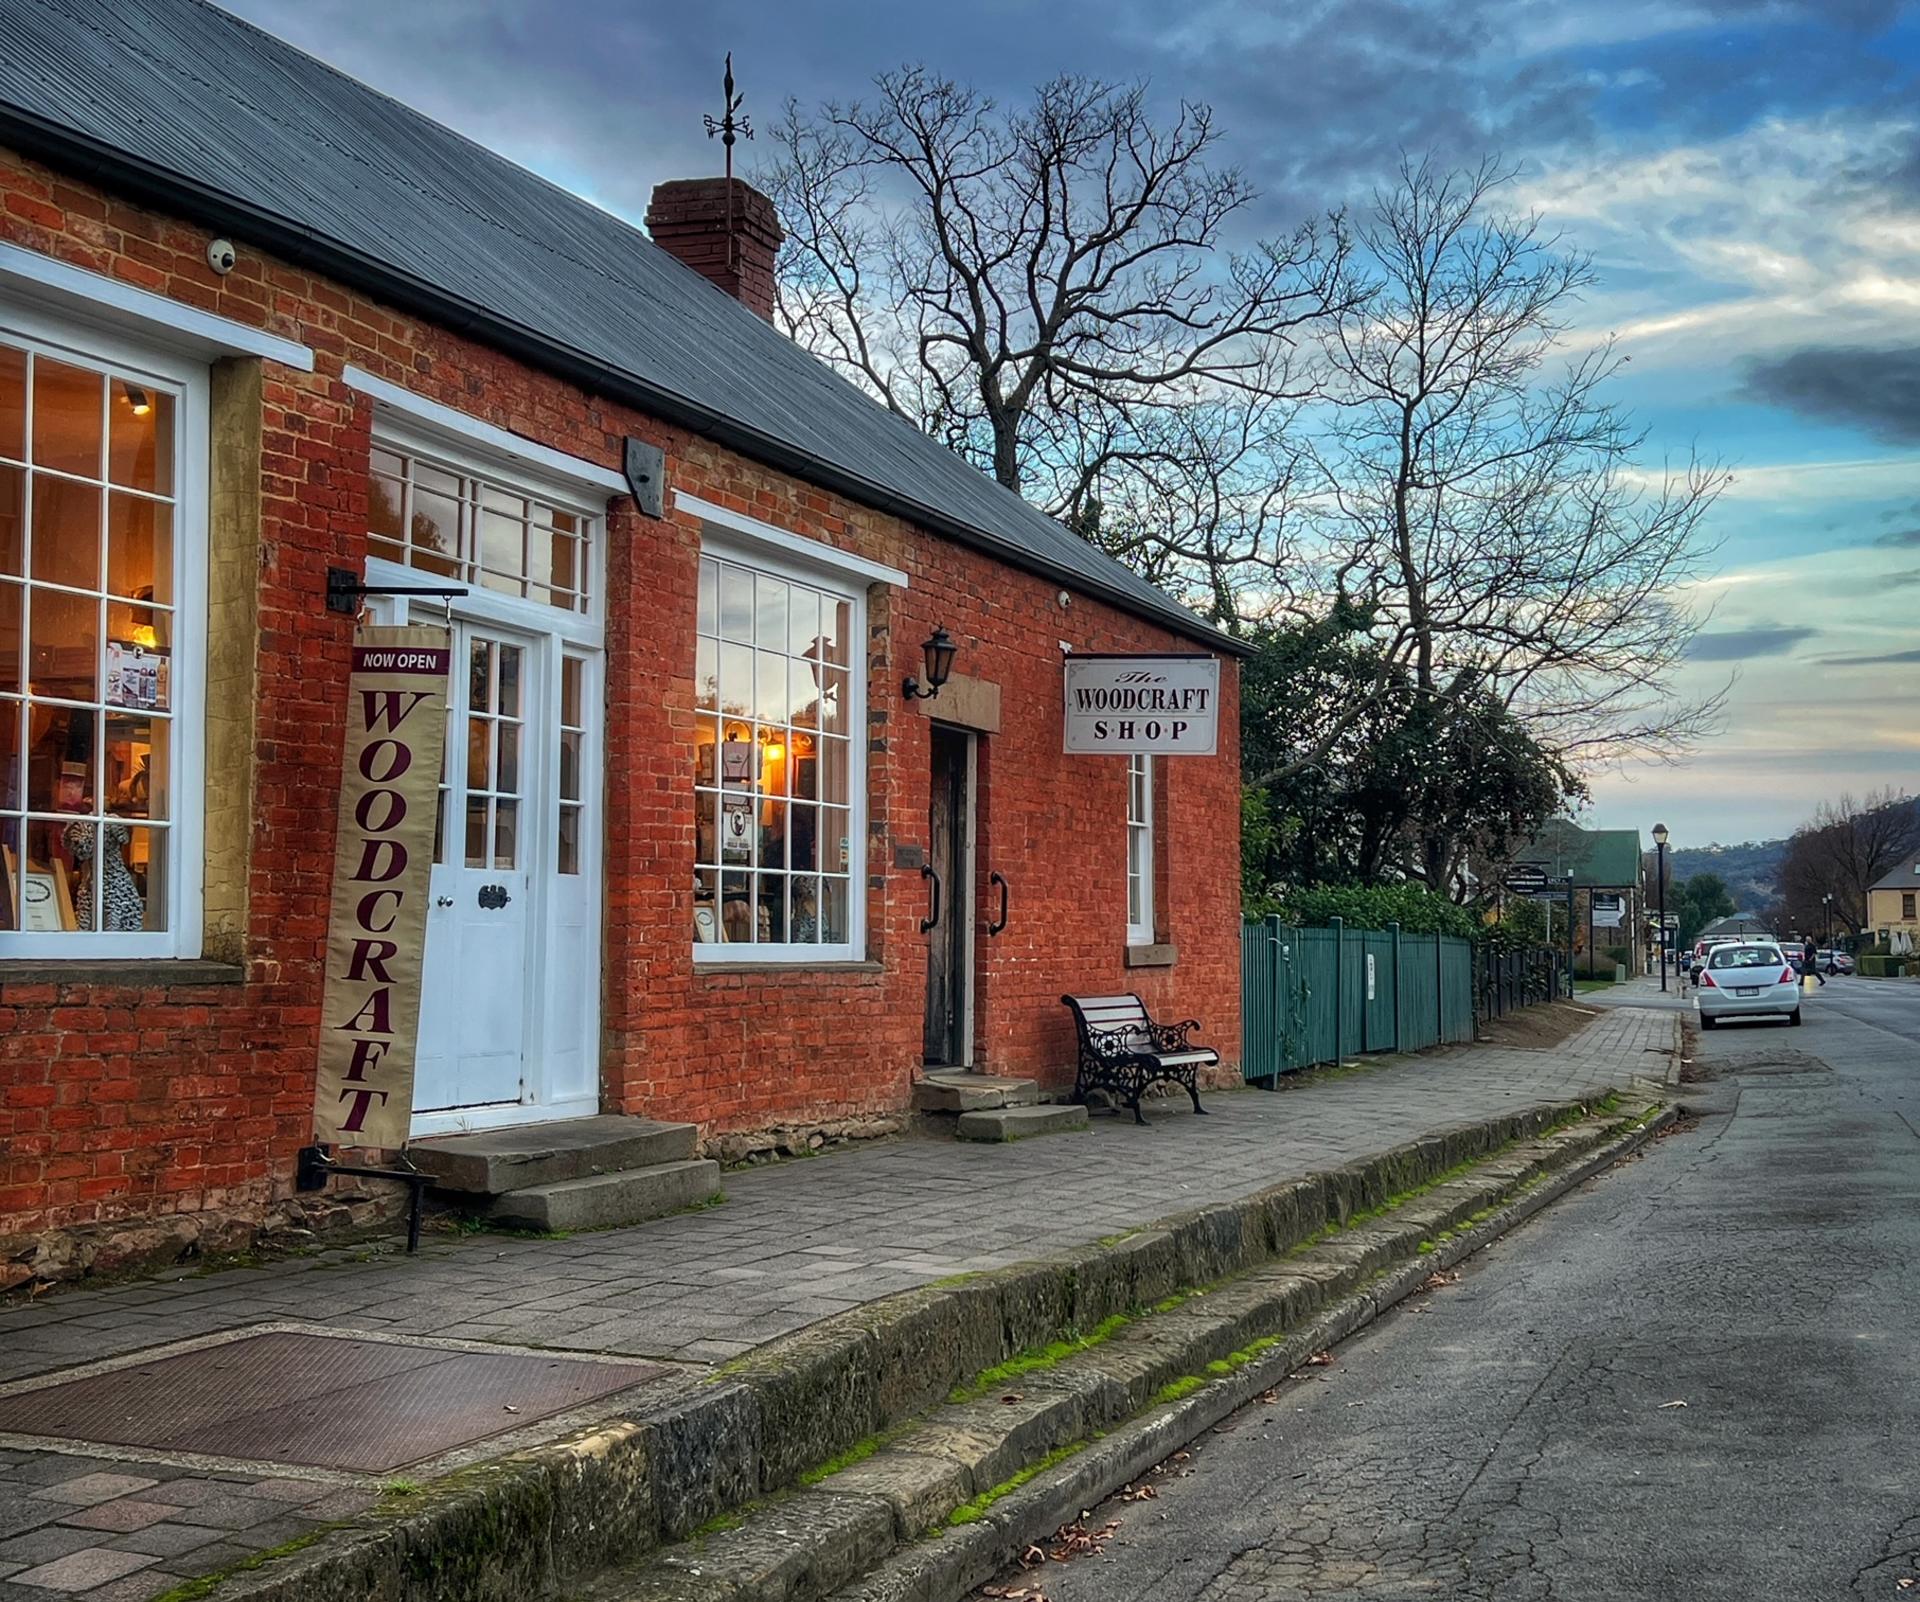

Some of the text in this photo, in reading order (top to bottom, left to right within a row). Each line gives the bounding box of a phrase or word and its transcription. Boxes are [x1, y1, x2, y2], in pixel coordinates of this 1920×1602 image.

[363, 653, 437, 669] NOW OPEN
[1115, 671, 1168, 684] The
[1074, 688, 1209, 712] WOODCRAFT
[334, 690, 436, 1133] WOODCRAFT
